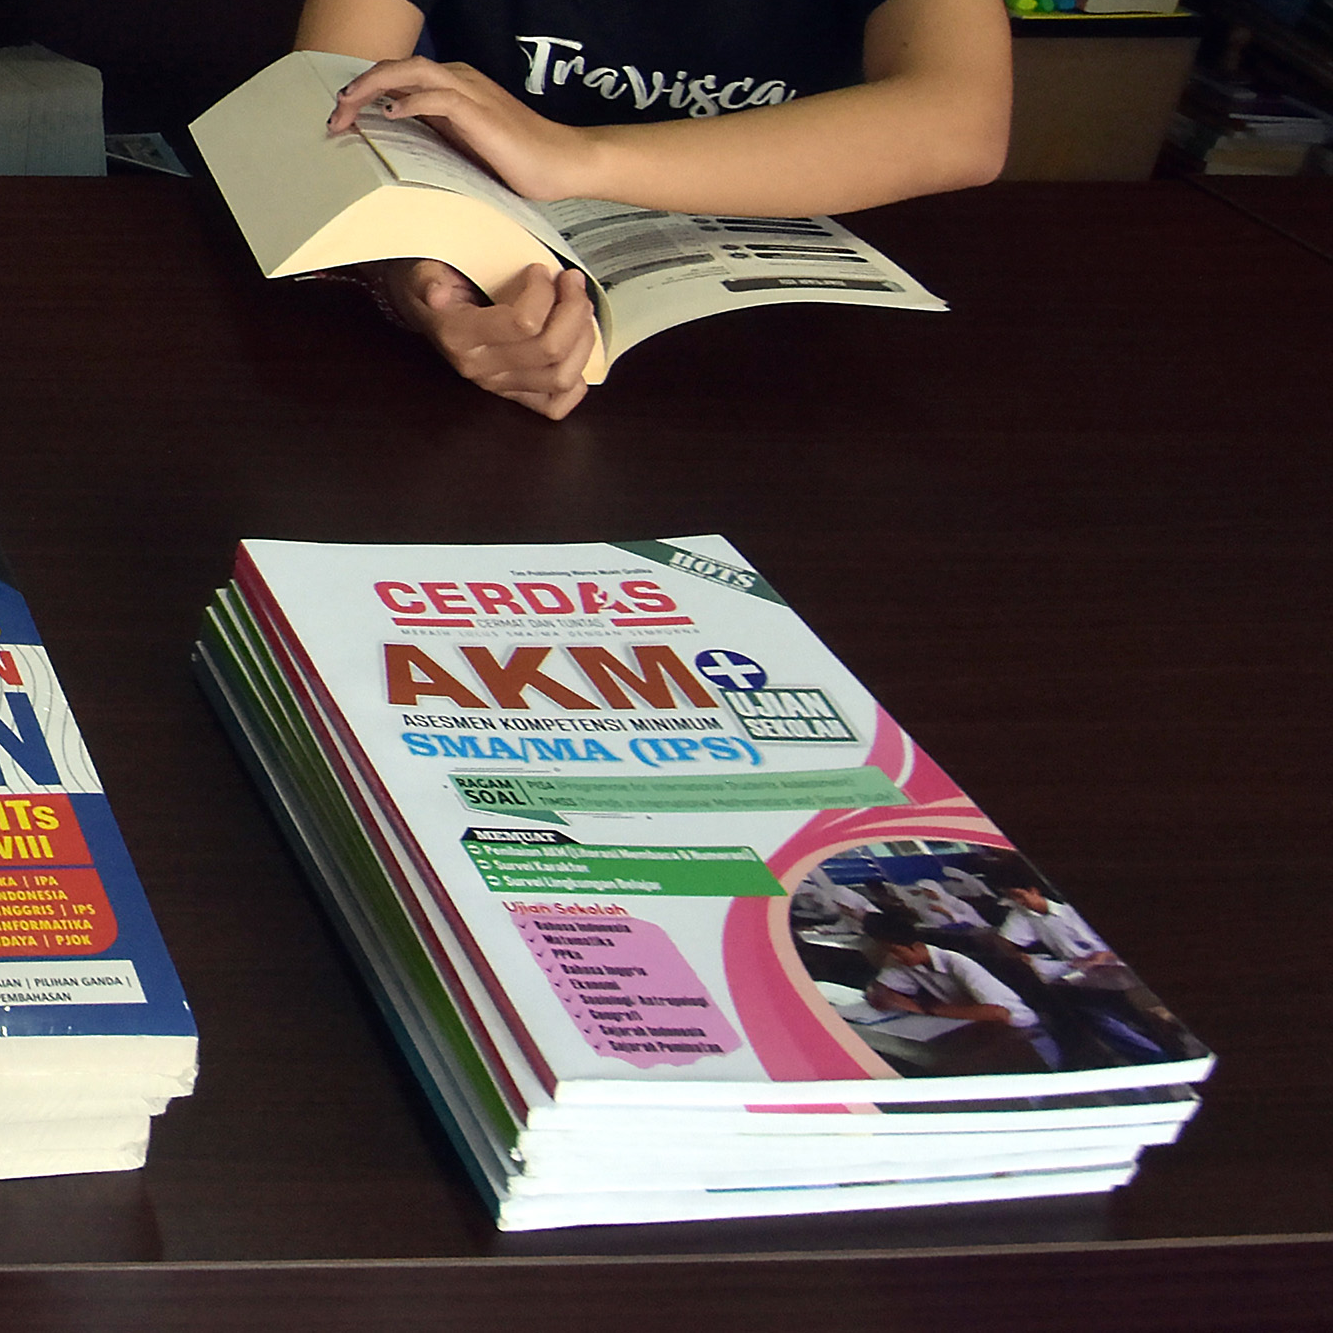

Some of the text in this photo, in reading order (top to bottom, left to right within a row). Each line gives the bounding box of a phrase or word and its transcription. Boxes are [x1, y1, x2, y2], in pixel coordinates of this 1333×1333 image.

[669, 551, 757, 589] HOTS
[374, 579, 679, 616] CERDAS
[382, 643, 721, 711] AKM
[730, 689, 829, 718] UJIAN
[402, 713, 723, 732] ASESMEN KOMPETENSI MINIMUM
[748, 716, 852, 739] SEKOLAH
[402, 732, 763, 767] SMA/MA (IPS)
[456, 777, 513, 790] RAGAM
[466, 790, 527, 807] SOAL
[474, 830, 557, 844] MEMUAT
[502, 900, 630, 916] Ujian Sekolah
